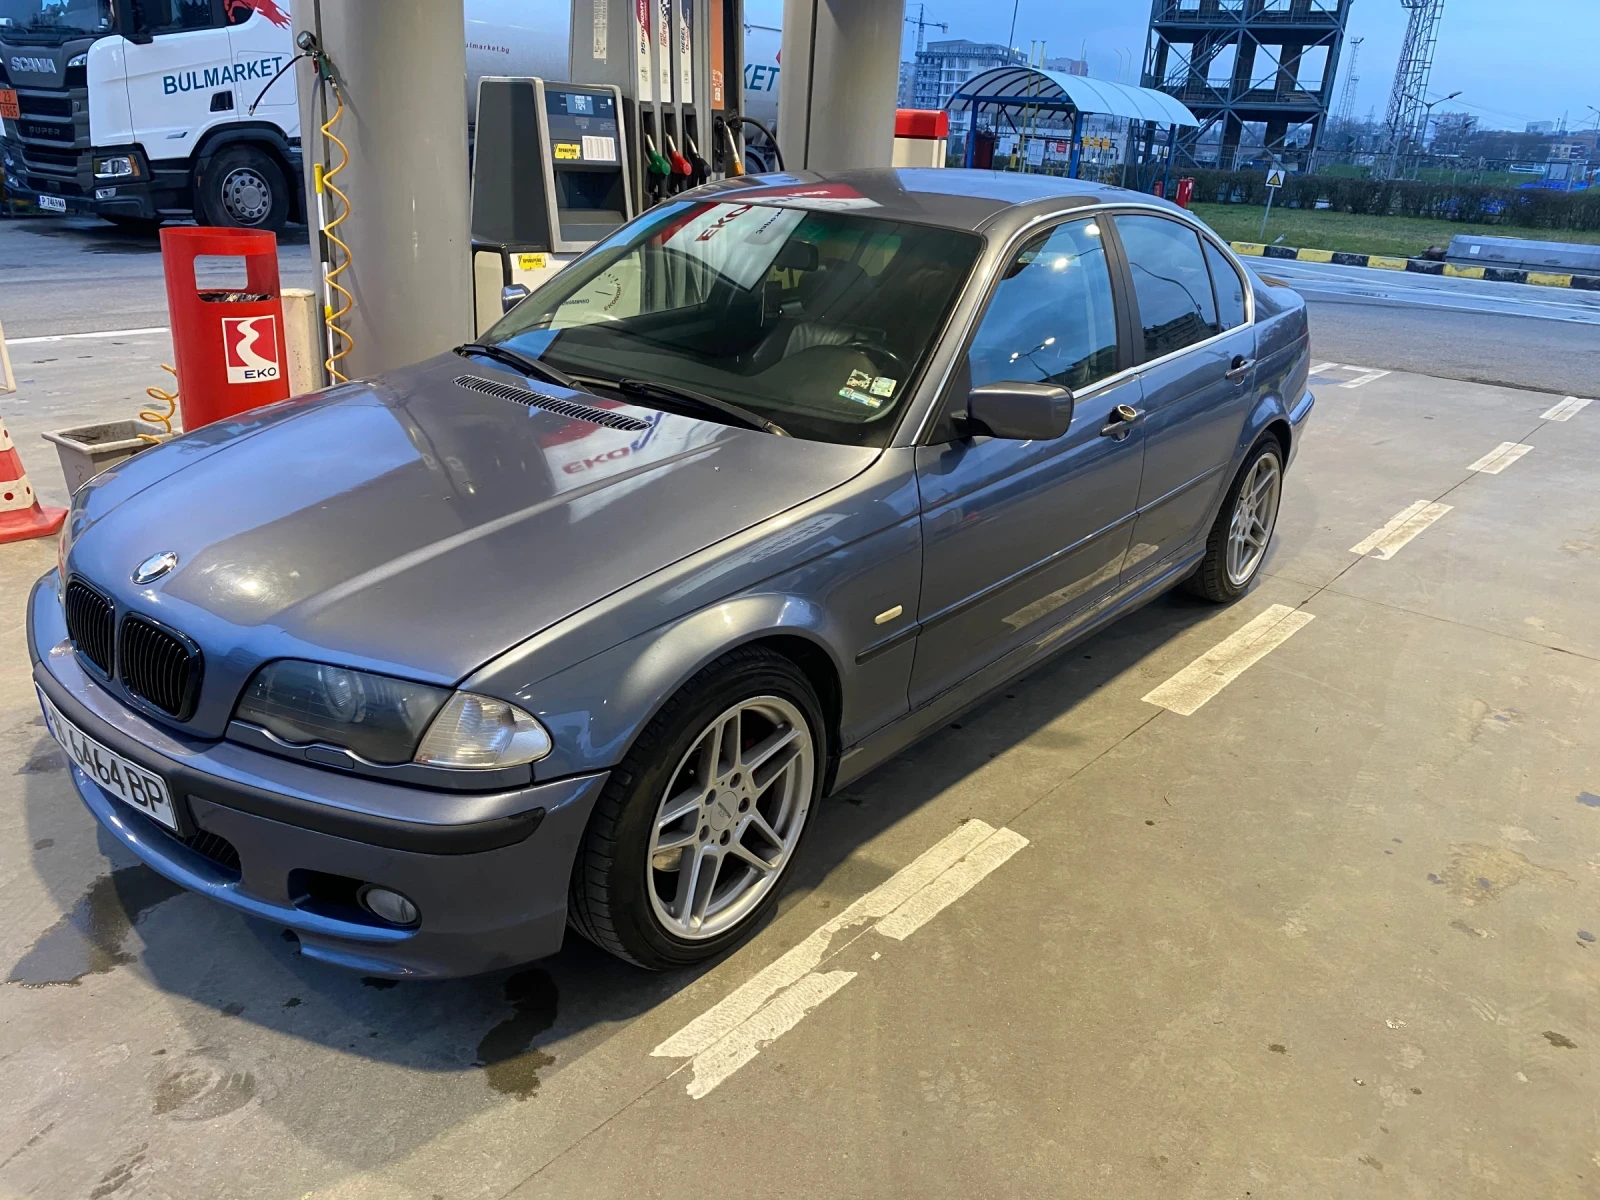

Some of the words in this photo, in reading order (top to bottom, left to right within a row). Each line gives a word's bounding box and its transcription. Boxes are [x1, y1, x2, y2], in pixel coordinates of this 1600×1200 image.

[11, 56, 57, 73] SCANIA
[163, 57, 283, 95] BULMARKET
[29, 126, 60, 136] SUPER
[604, 283, 622, 311] EKONOMY
[244, 367, 277, 379] EKO
